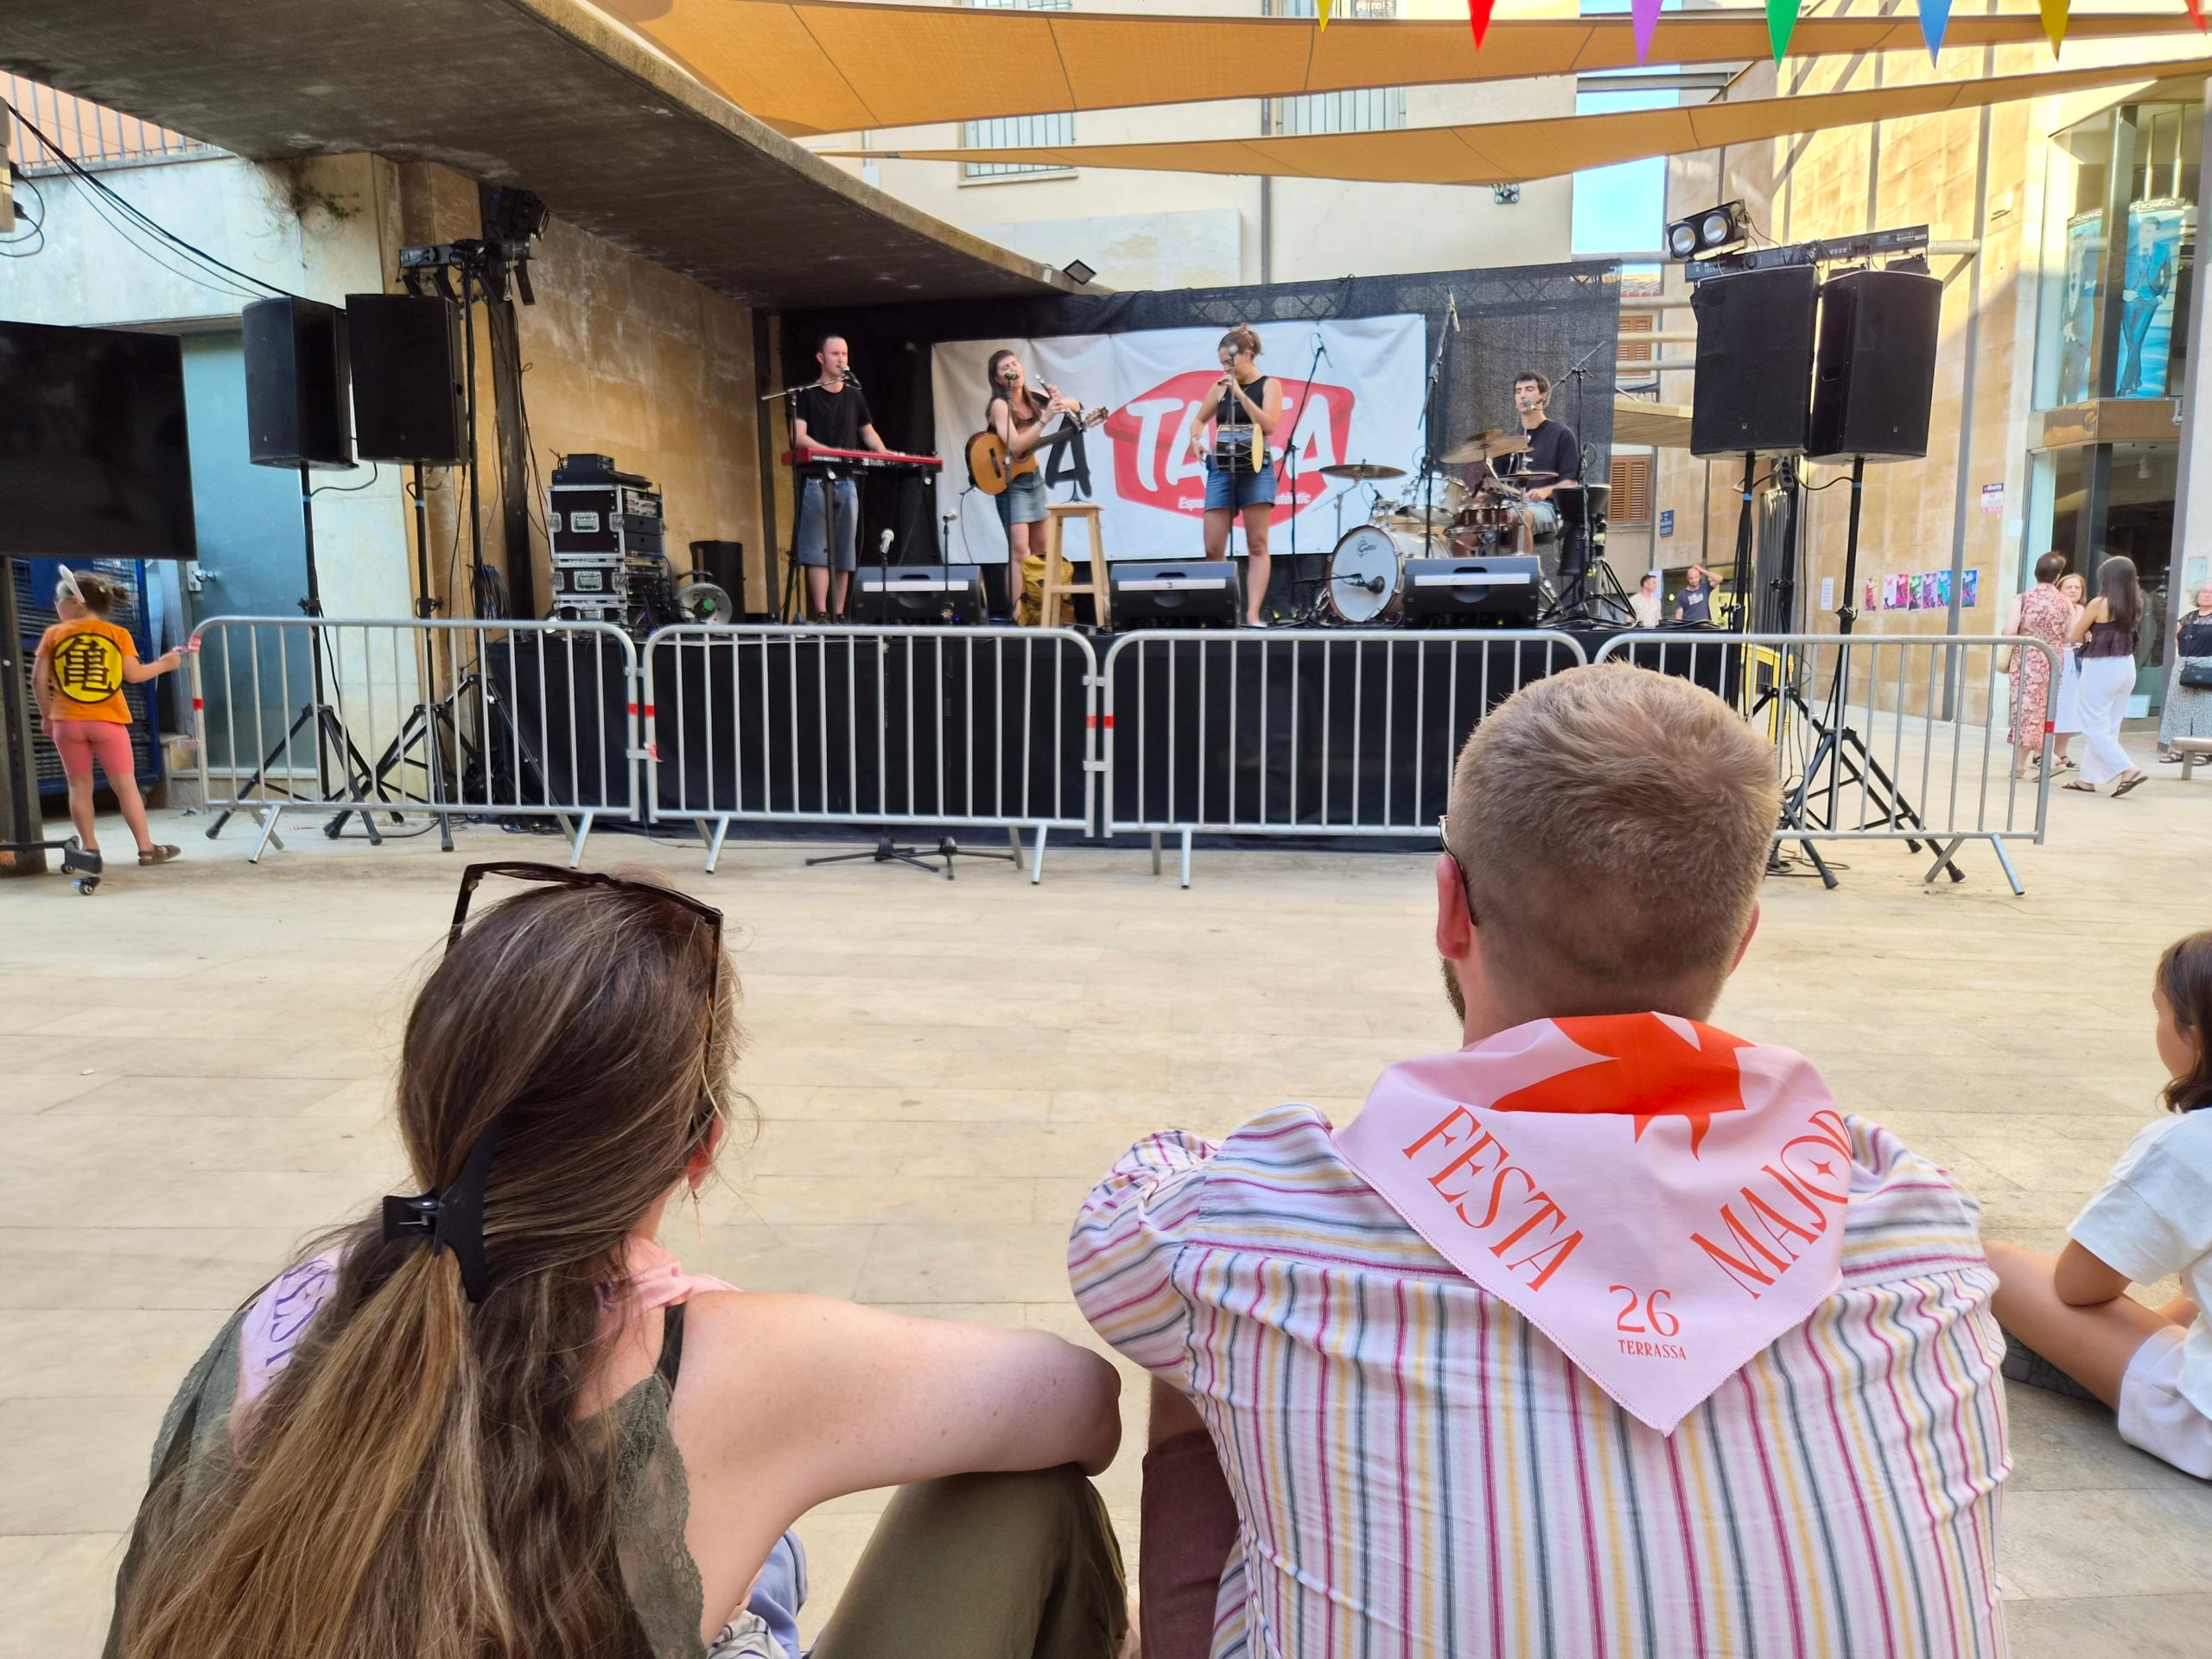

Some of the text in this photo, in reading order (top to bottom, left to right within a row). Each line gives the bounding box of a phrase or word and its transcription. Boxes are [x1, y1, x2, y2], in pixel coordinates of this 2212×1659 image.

[1126, 393, 1337, 493] TAA
[1402, 1104, 1584, 1293] FESTA
[1609, 1284, 1680, 1337] 26
[1618, 1338, 1687, 1361] TERRASSA
